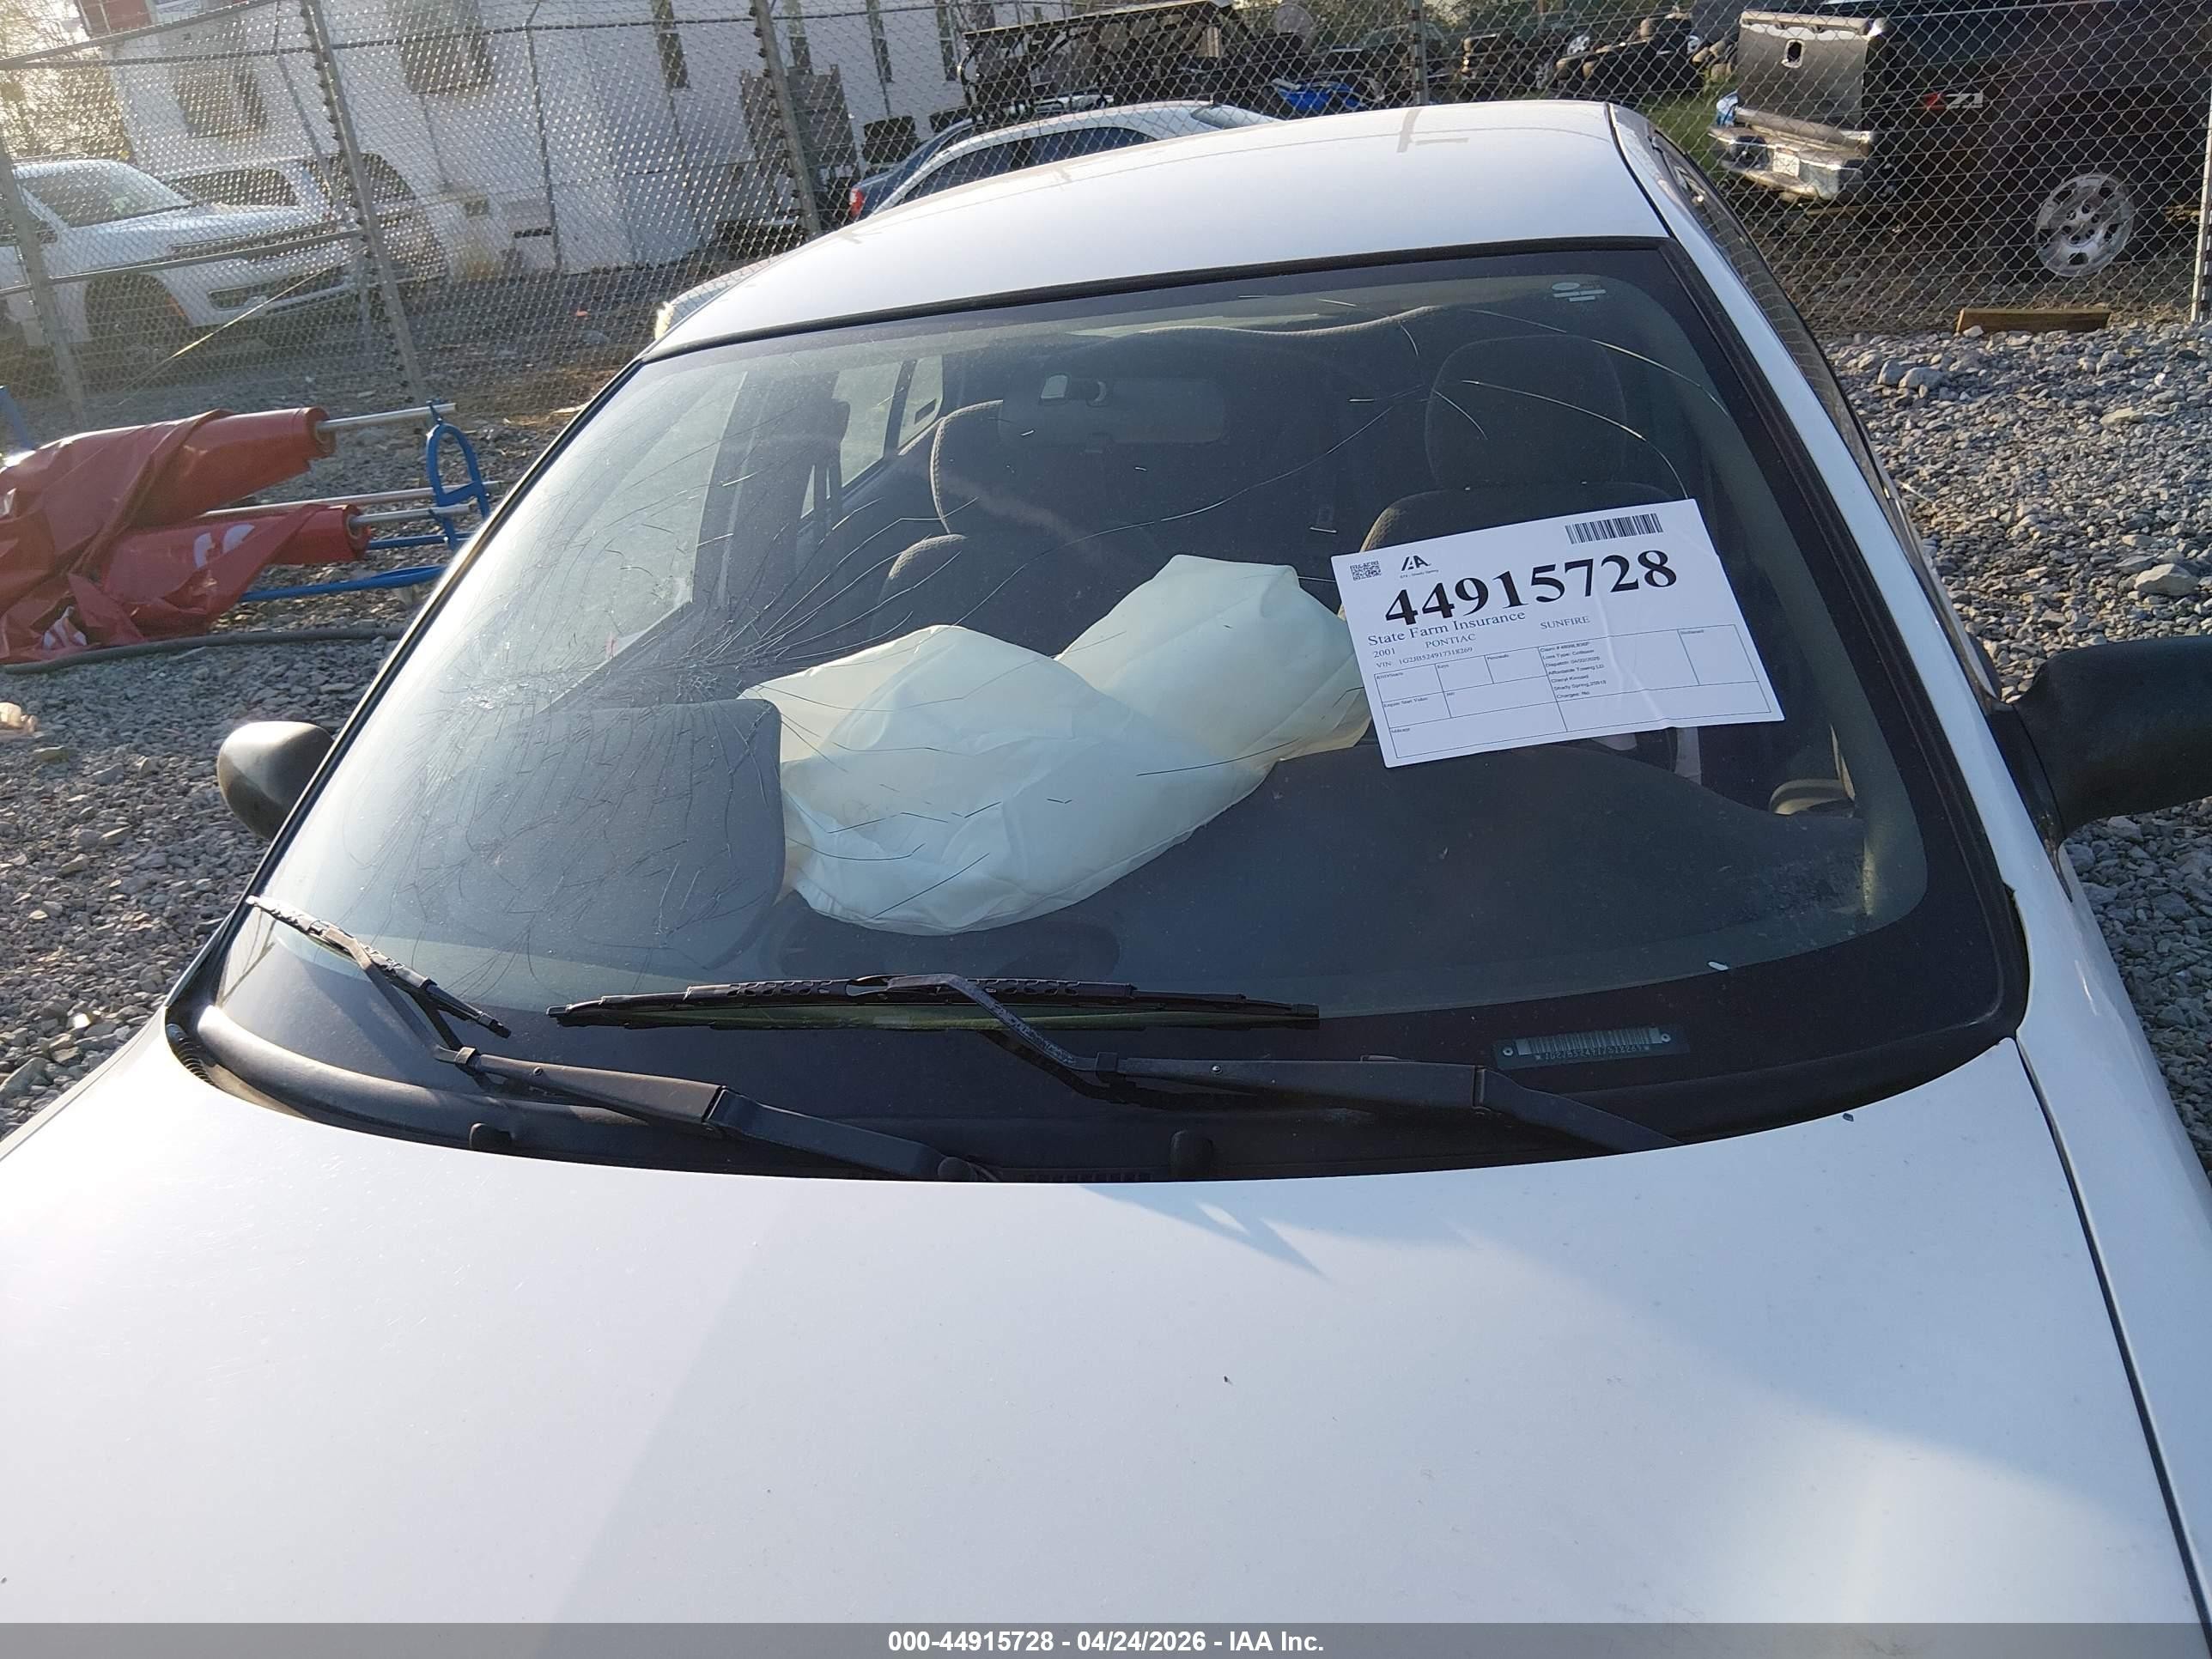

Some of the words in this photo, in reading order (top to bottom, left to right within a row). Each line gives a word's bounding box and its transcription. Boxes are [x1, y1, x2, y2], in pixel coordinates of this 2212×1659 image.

[1385, 550, 1677, 626] 44915728
[1368, 631, 1406, 646] State
[1409, 625, 1449, 639] Farm
[1454, 611, 1526, 630] Insurance
[1373, 647, 1396, 659] 2001
[1425, 633, 1477, 649] PONTIAC
[1540, 616, 1591, 630] SUNFIRE
[1376, 660, 1392, 669] VIN
